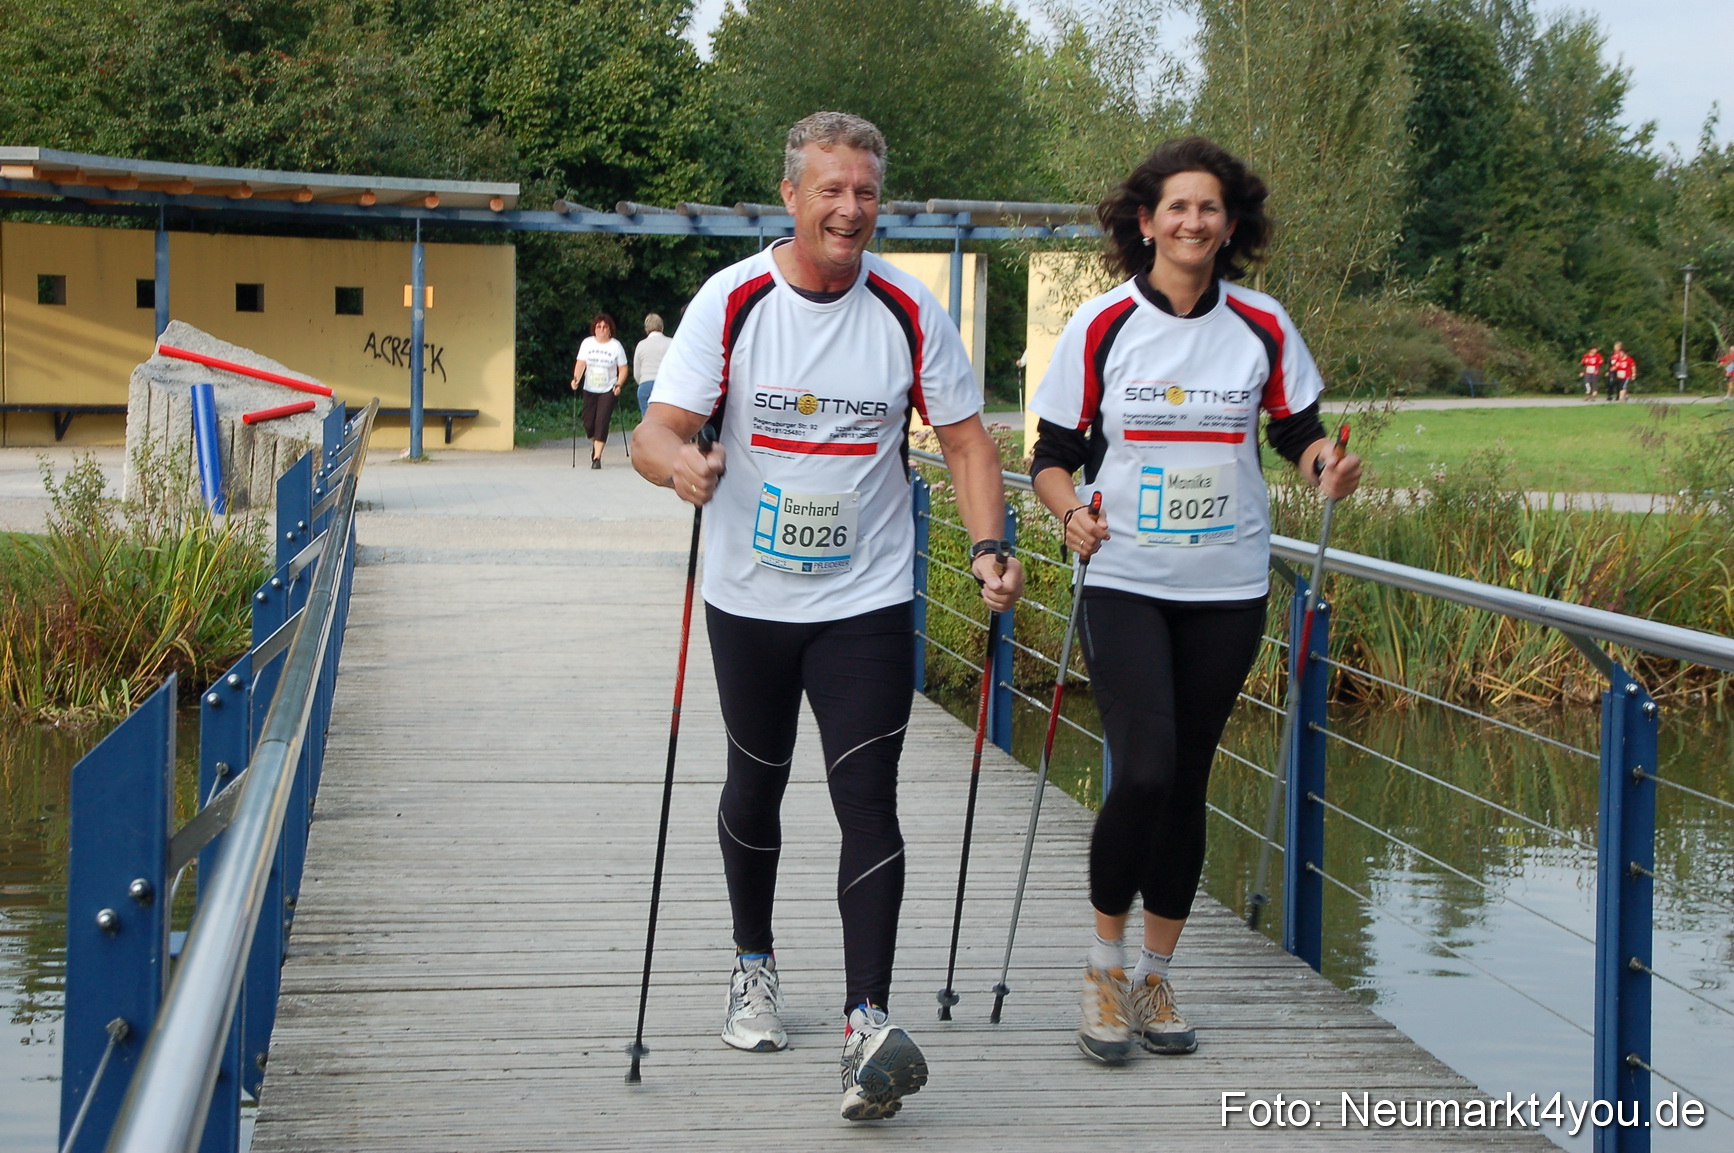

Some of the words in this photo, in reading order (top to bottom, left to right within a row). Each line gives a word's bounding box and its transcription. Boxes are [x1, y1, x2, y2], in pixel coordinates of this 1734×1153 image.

[1168, 474, 1212, 489] Monika
[784, 497, 840, 517] Gerhard
[1168, 495, 1230, 520] 8027
[781, 523, 848, 548] 8026
